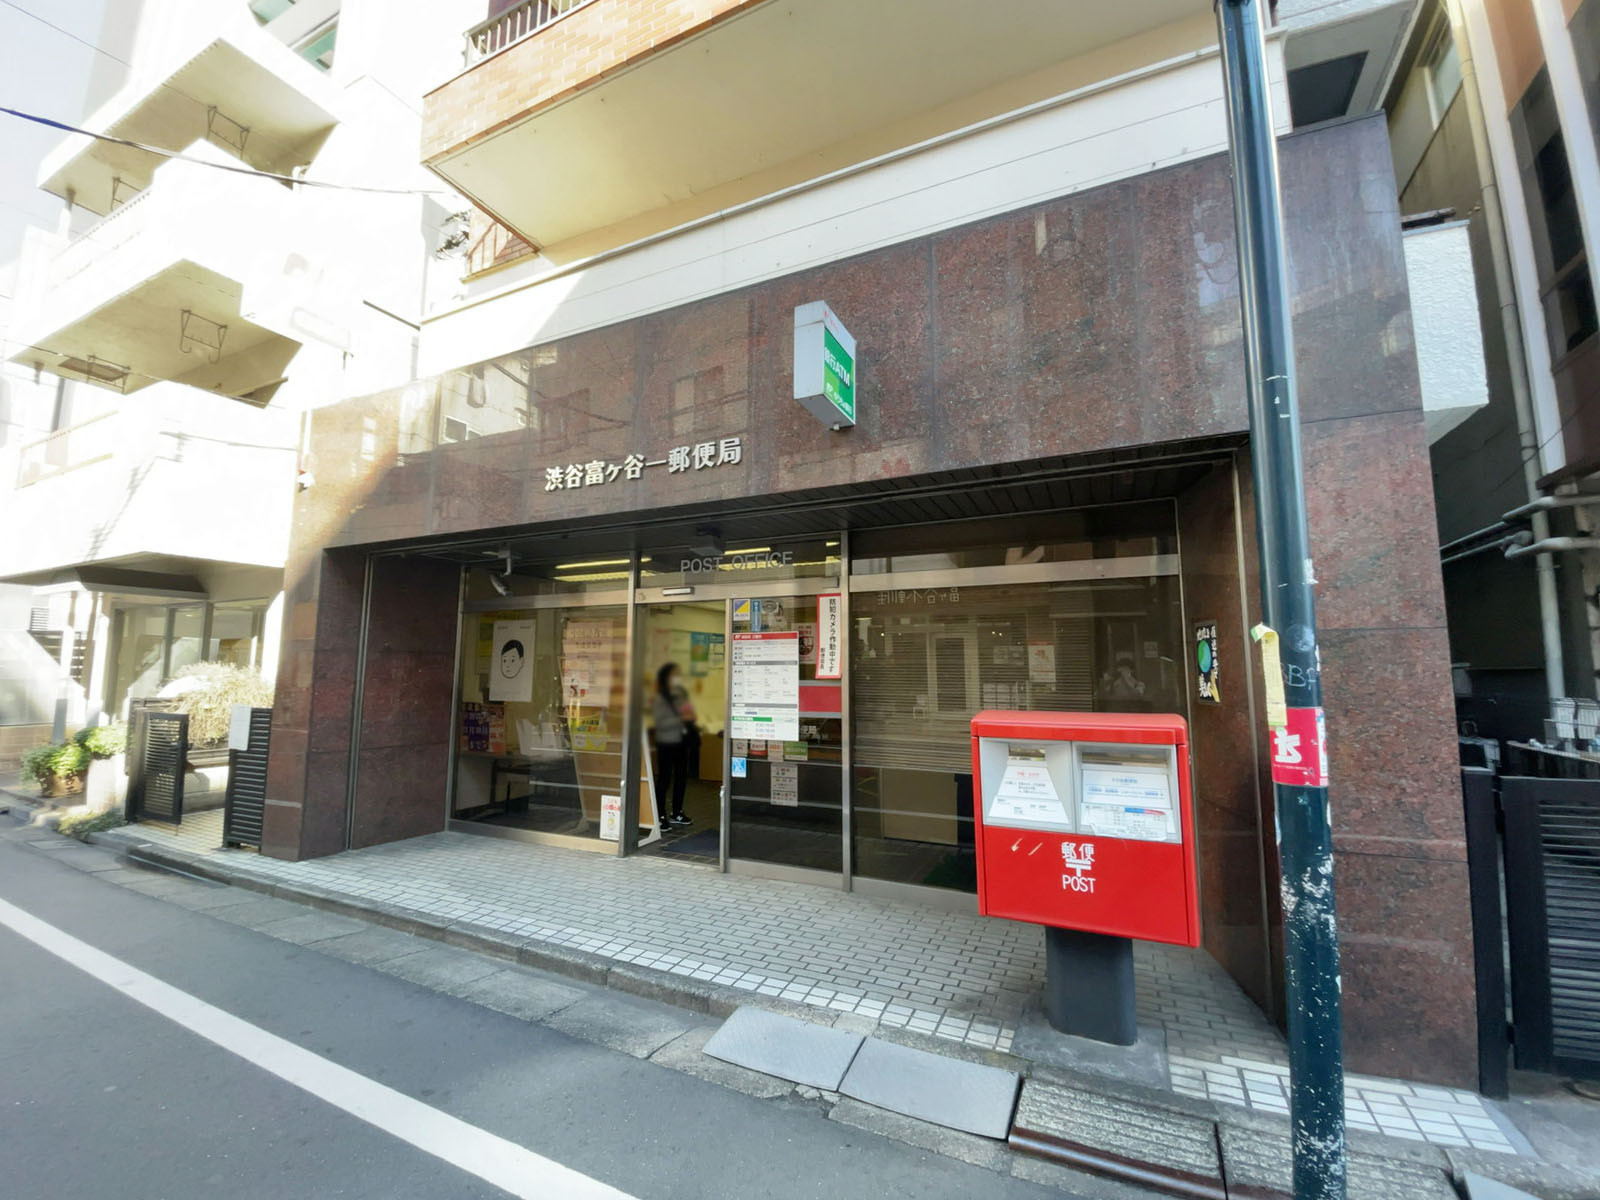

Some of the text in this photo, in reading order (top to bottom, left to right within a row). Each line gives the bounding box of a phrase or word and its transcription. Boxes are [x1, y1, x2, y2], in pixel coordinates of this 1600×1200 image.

[544, 437, 742, 492] 渋谷富ヶ谷一郵便局
[680, 551, 794, 574] POST OFFICE
[829, 598, 837, 673] 防犯カメラ作動中です
[1061, 842, 1096, 862] 郵便
[1062, 874, 1096, 894] POST
